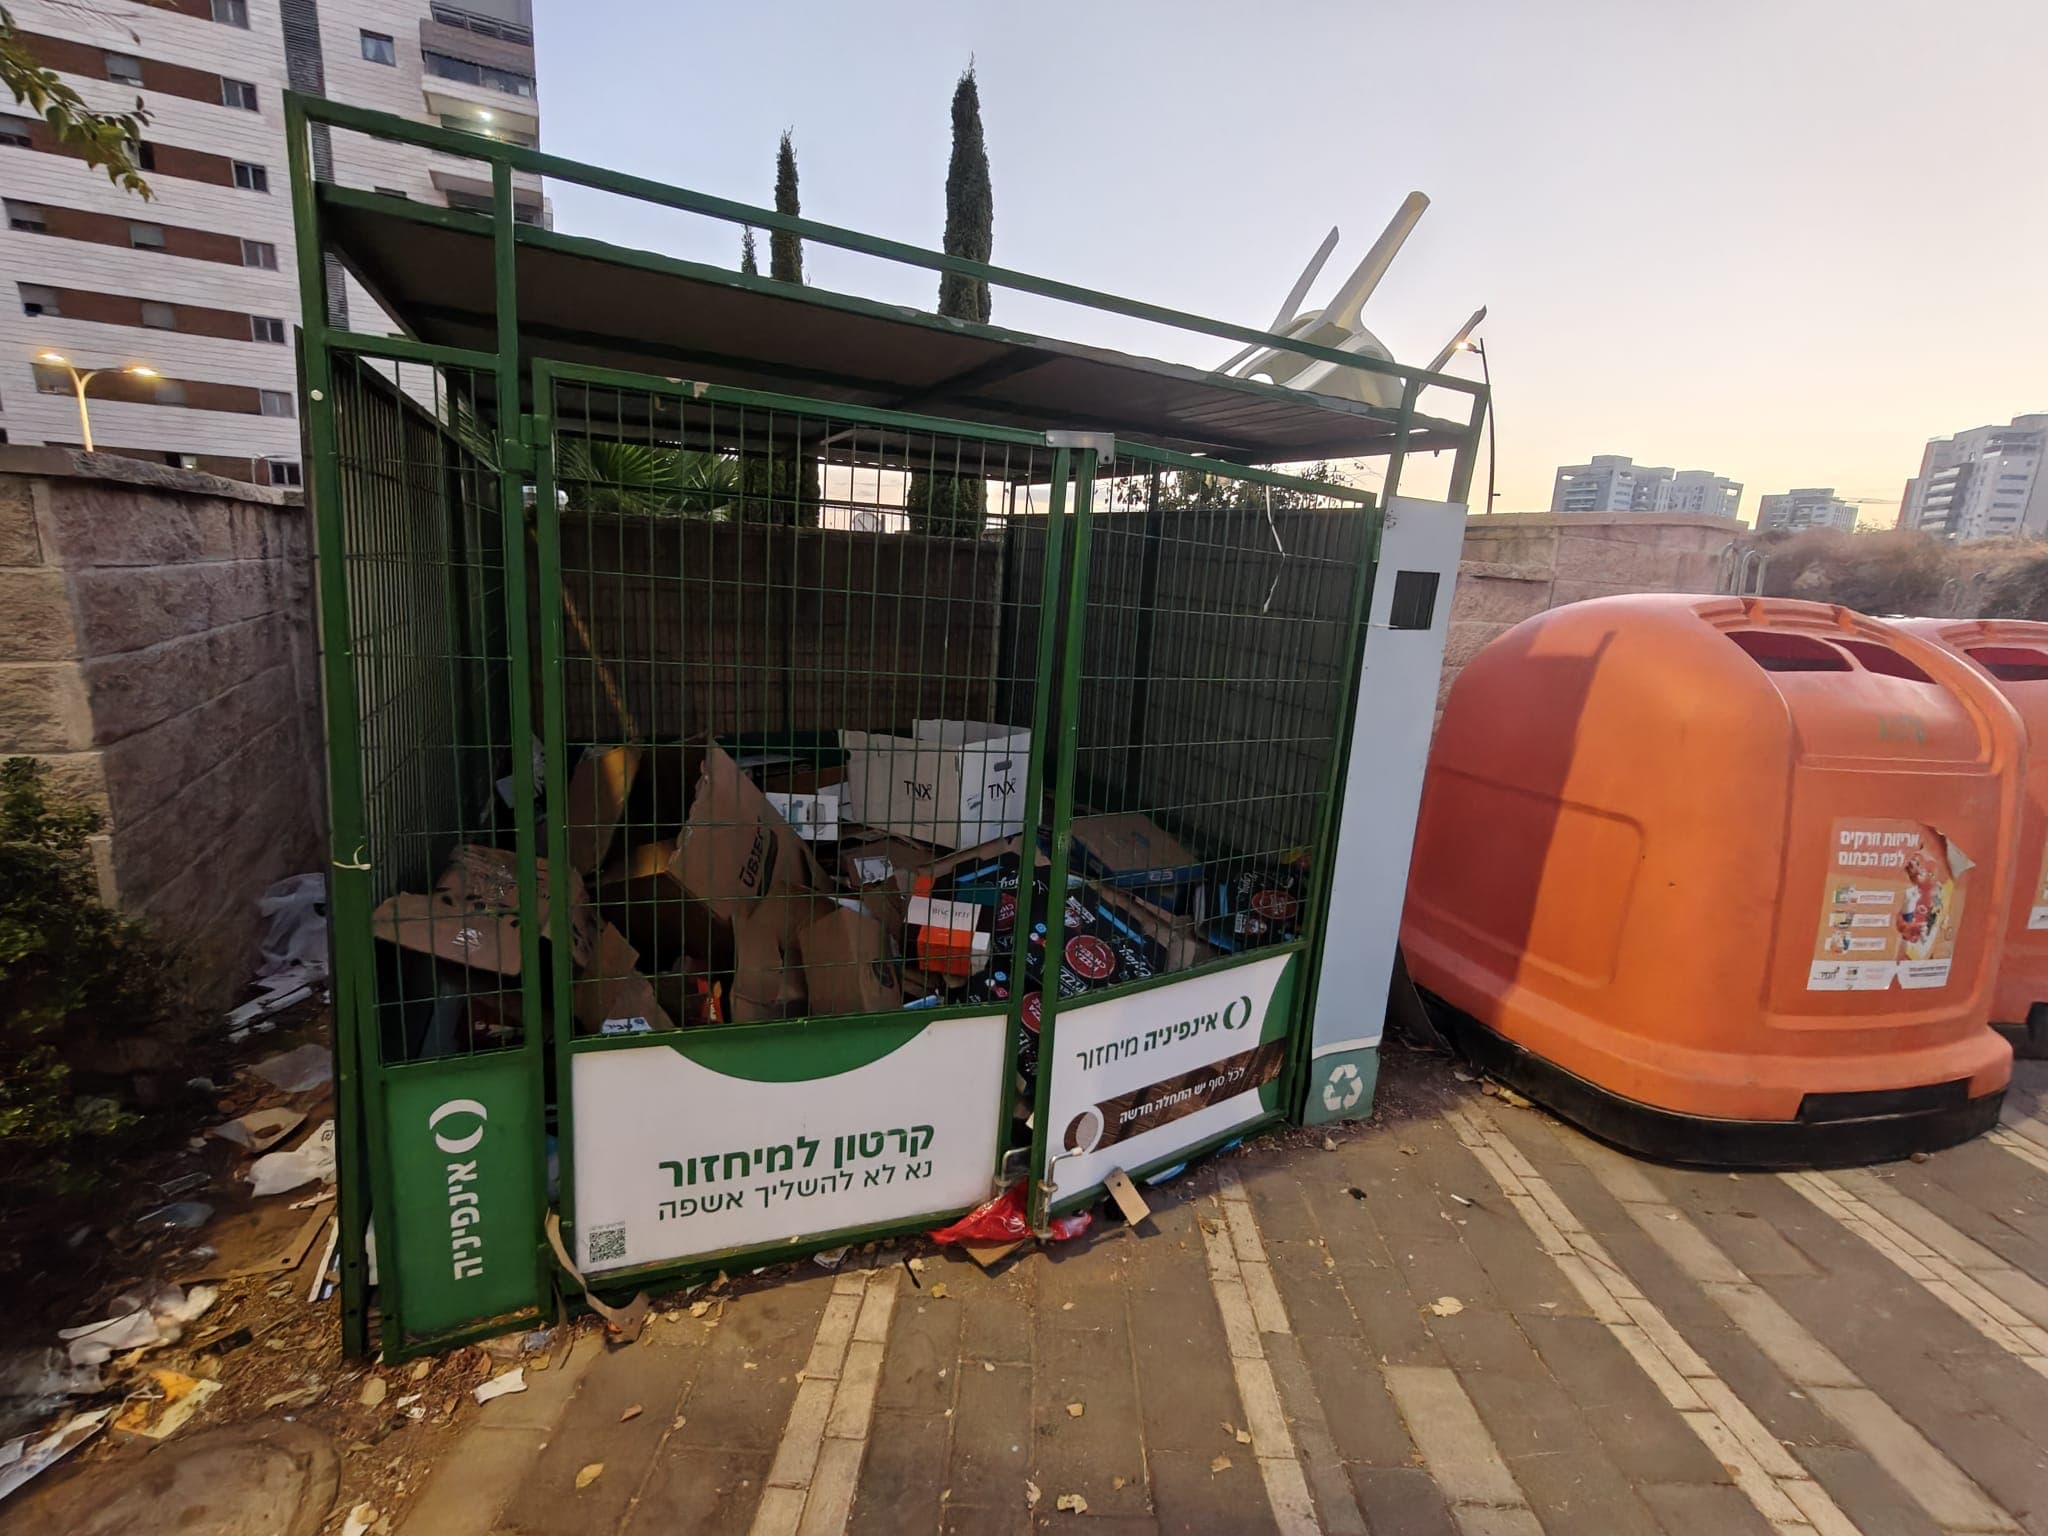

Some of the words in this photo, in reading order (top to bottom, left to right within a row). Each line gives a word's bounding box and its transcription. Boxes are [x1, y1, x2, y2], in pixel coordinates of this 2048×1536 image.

[1880, 848, 1904, 867] לפח
[1143, 1011, 1218, 1051] אינפיניה
[1075, 1035, 1138, 1070] מיחזור
[1208, 1075, 1225, 1092] סוף
[1227, 1066, 1245, 1082] לכל
[1154, 1087, 1192, 1111] התחלה
[1193, 1082, 1207, 1095] יש
[1119, 1102, 1152, 1124] חדשה
[833, 1124, 935, 1169] קרטון
[658, 1135, 820, 1187] למיחזור
[904, 1159, 933, 1180] נא
[862, 1163, 896, 1187] לא
[754, 1169, 853, 1208] להשליך
[658, 1190, 744, 1220] אשפה
[446, 1159, 484, 1281] אינפיניה
